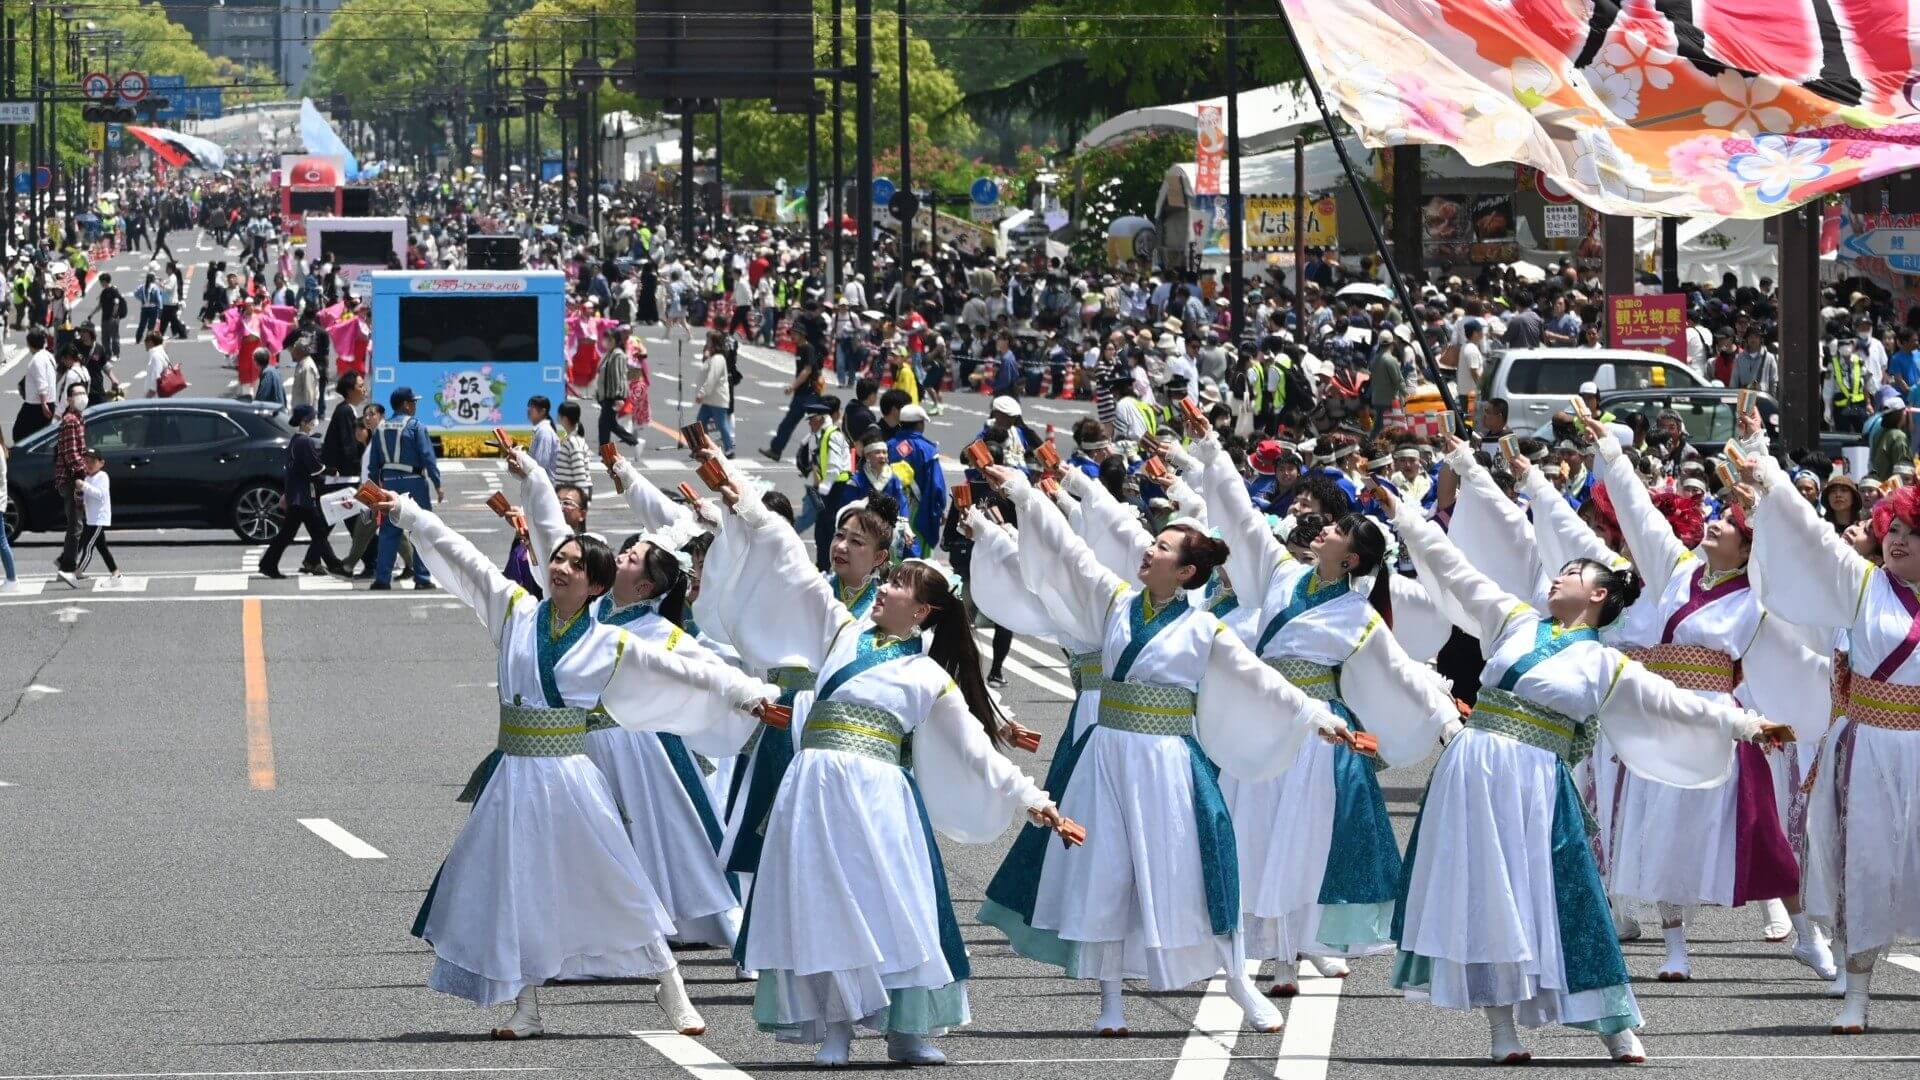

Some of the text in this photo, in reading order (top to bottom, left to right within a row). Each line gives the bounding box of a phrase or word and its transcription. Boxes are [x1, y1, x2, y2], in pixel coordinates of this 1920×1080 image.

[1260, 211, 1320, 233] たまん
[1616, 308, 1681, 325] 観光物産
[1616, 325, 1680, 336] フリーマーケット
